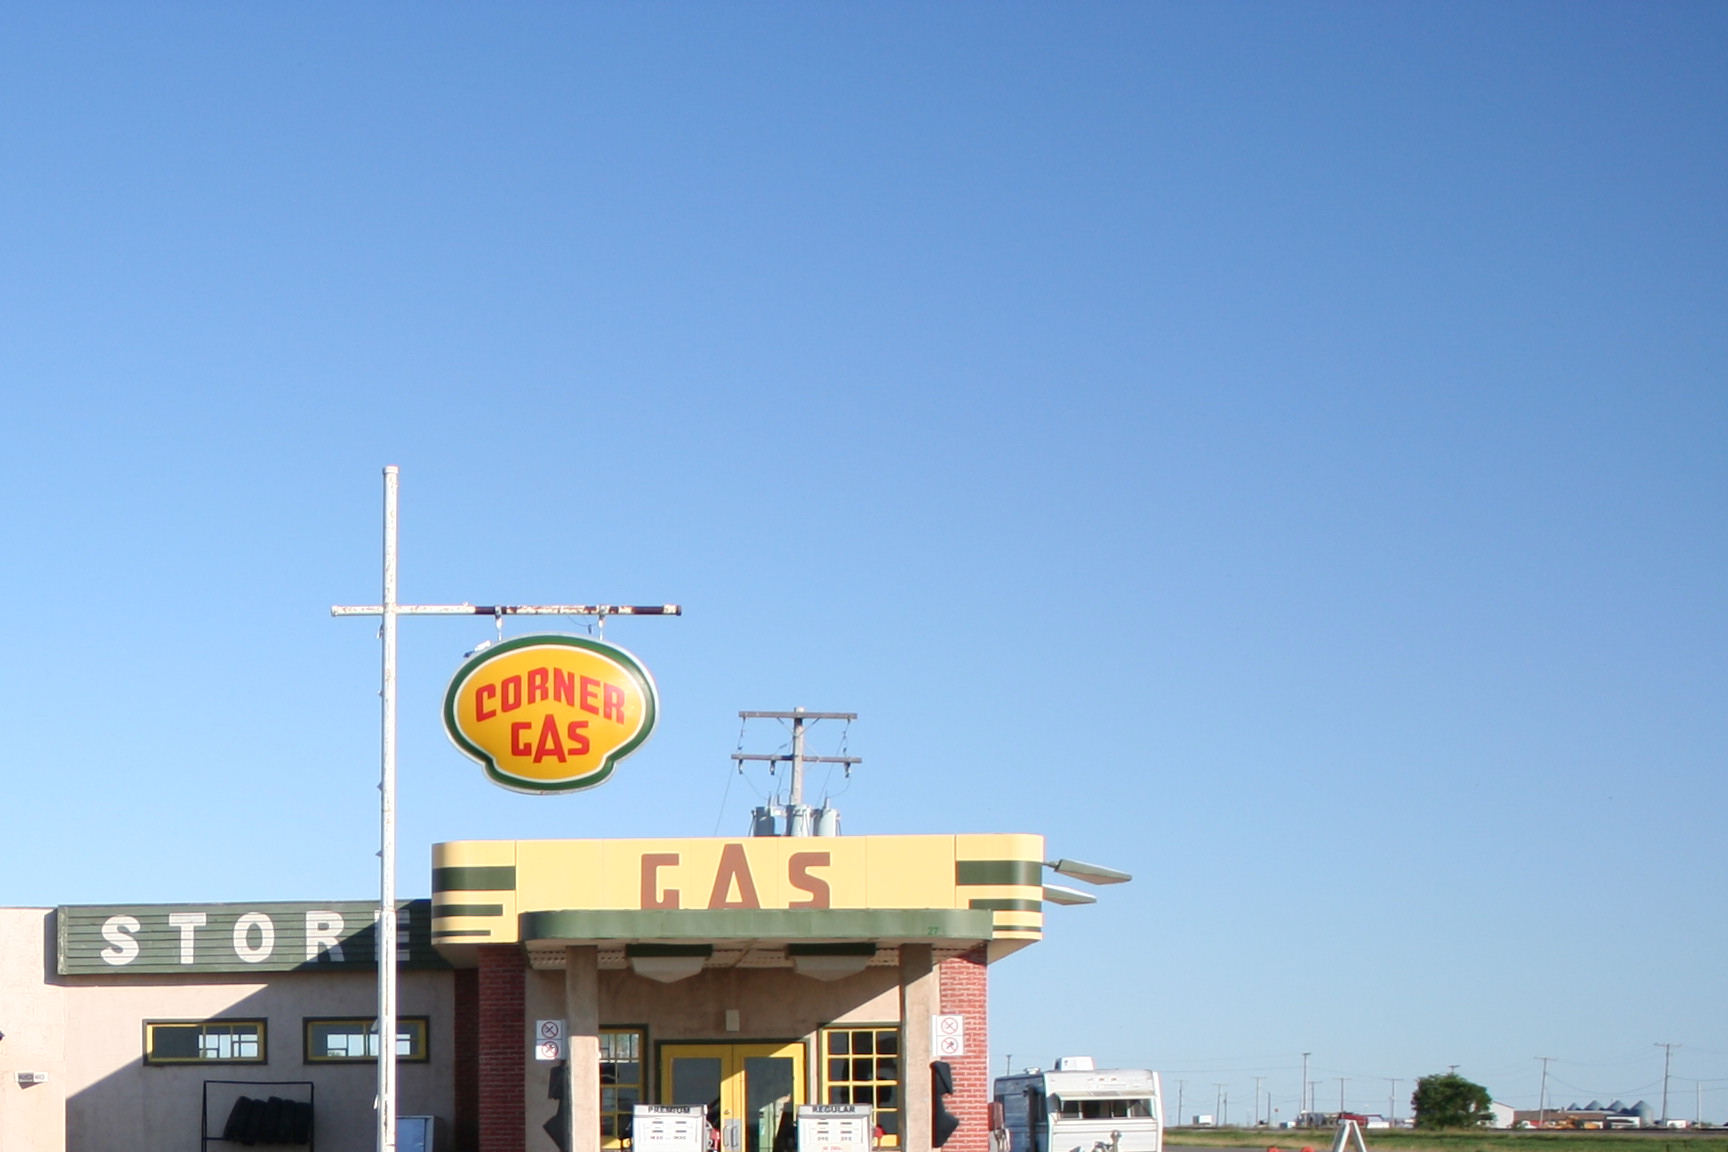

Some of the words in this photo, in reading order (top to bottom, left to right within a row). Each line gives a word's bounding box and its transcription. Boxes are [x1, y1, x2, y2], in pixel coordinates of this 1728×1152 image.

[475, 666, 626, 726] CORNER
[510, 713, 591, 764] GAS
[640, 843, 831, 910] GAS
[100, 909, 411, 966] STORE
[812, 1105, 856, 1114] REGULAR
